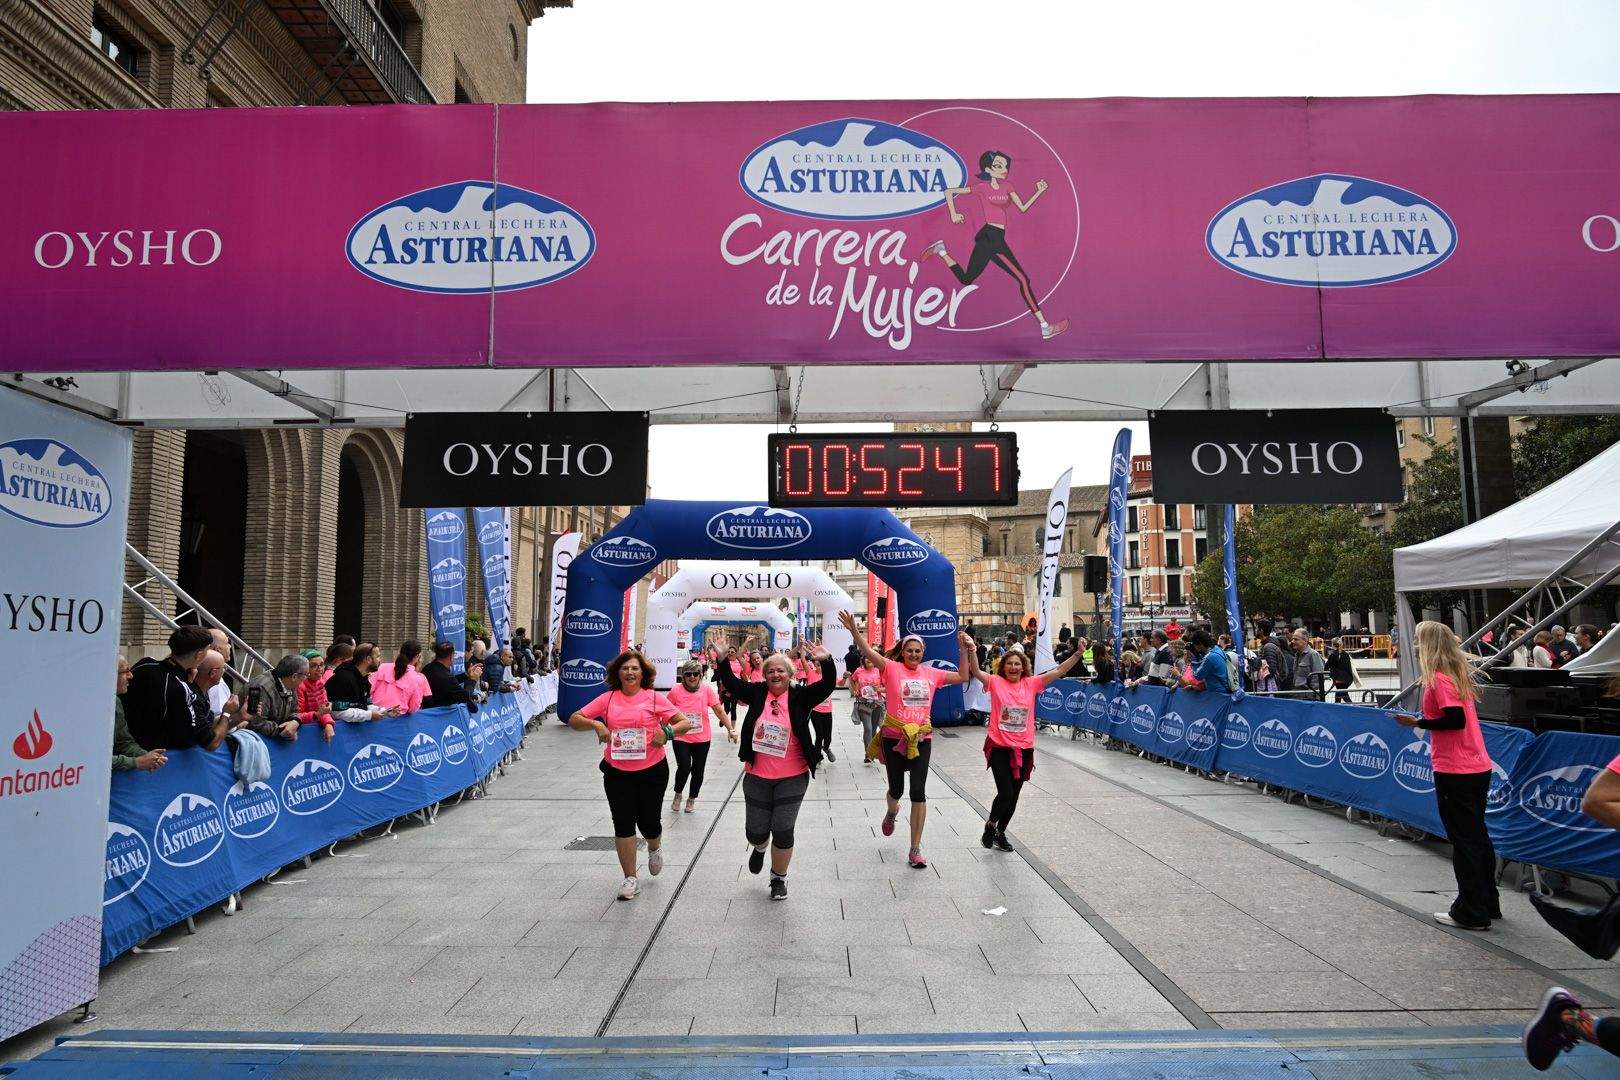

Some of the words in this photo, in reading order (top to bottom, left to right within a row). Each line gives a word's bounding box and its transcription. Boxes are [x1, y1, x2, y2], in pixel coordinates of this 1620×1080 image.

[792, 153, 863, 164] CENTRAL
[870, 153, 942, 163] LECHERA
[758, 155, 949, 194] ASTURIANA
[404, 220, 481, 232] CENTRAL
[489, 218, 569, 230] LECHERA
[1263, 213, 1341, 225] CENTRAL
[1349, 212, 1429, 224] LECHERA
[33, 228, 223, 269] OYSHO
[364, 223, 577, 265] ASTURIANA
[720, 213, 907, 267] Carrera
[1226, 215, 1440, 259] ASTURIANA
[765, 269, 801, 306] de
[808, 269, 834, 306] la
[828, 261, 978, 351] Mujer
[443, 442, 613, 477] OYSHO
[1191, 441, 1363, 476] OYSHO
[12, 461, 57, 479] CENTRAL
[60, 472, 100, 489] LECHERA
[714, 518, 804, 539] ASTURIANA
[730, 517, 765, 525] CENTRAL
[766, 517, 801, 525] LECHERA
[1141, 509, 1149, 551] HOTEL
[594, 548, 651, 560] ASTURIANA
[868, 550, 924, 560] ASTURIANA
[711, 572, 792, 590] OYSHO
[3, 593, 104, 634] YSHO
[565, 619, 609, 631] ASTURIANA
[910, 621, 954, 632] ASTURIANA
[561, 669, 605, 681] ASTURIANA
[1255, 730, 1289, 750] ASTURIANA
[1296, 737, 1333, 760] ASTURIANA
[1342, 746, 1386, 771] ASTURIANA
[1395, 755, 1434, 783] ASTURIAN
[0, 763, 84, 797] ntander
[353, 760, 401, 786] ASTURIANA
[287, 777, 341, 807] ASTURIANA
[1547, 784, 1585, 793] CENTRA
[228, 799, 278, 829] ASTURIANA
[162, 817, 223, 857] ASTURIANA
